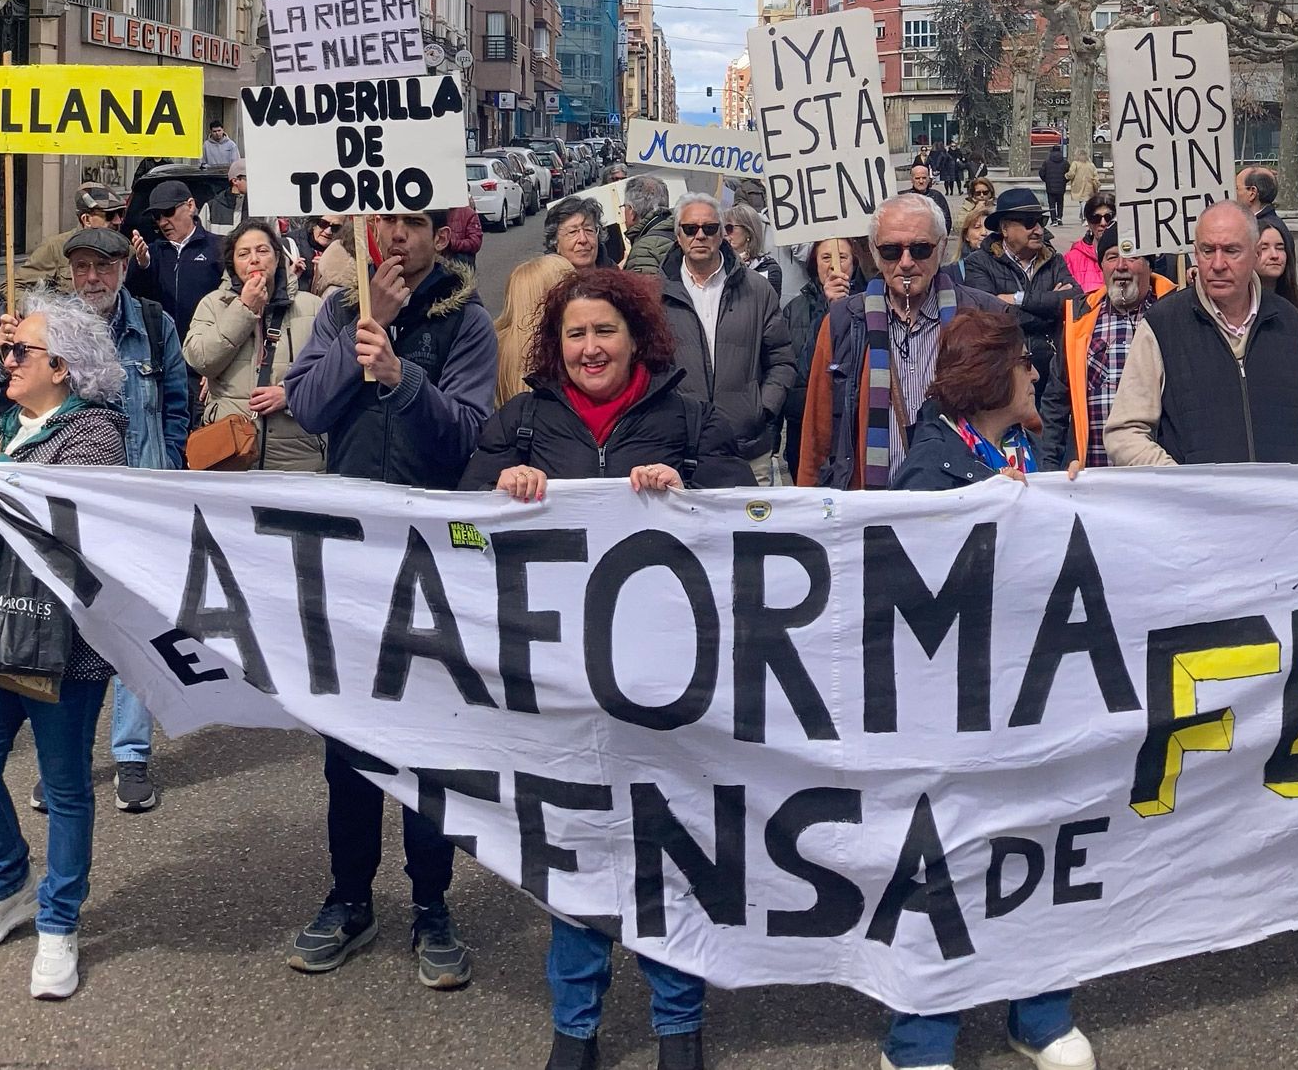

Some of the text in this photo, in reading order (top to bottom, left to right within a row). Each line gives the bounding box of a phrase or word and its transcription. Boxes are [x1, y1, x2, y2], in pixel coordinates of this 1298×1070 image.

[268, 5, 307, 34] LA
[273, 41, 317, 74] SE
[321, 28, 423, 70] MUERE
[768, 26, 856, 91] ¡YA
[1135, 30, 1197, 81] 15
[241, 75, 463, 126] VALDERILLA
[760, 77, 885, 162] ESTÁ
[1116, 84, 1227, 141] AÑOS
[336, 125, 384, 168] DE
[1135, 136, 1223, 193] SIN
[291, 167, 433, 213] TORIO
[984, 816, 1110, 919] DE
